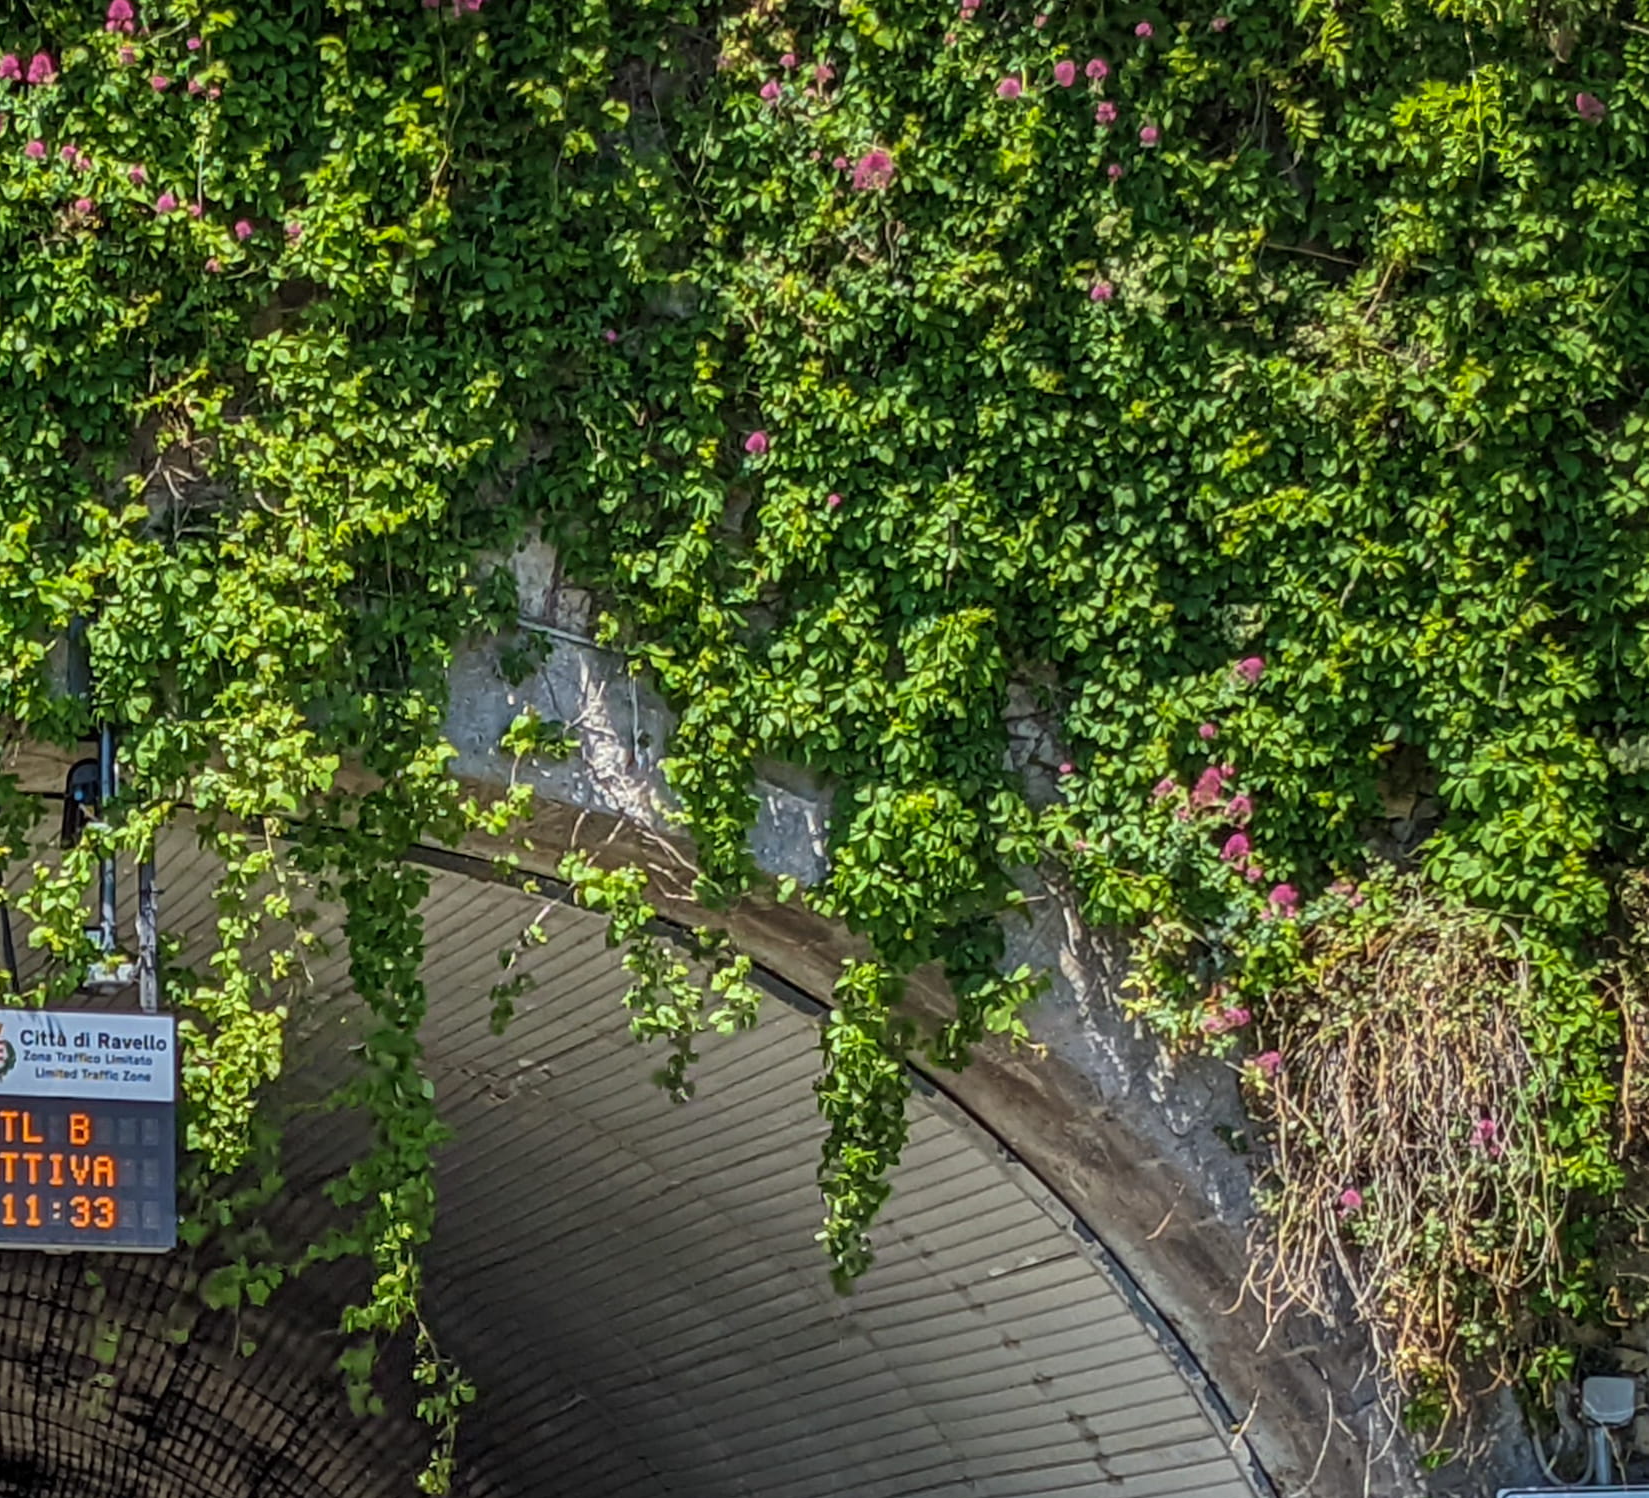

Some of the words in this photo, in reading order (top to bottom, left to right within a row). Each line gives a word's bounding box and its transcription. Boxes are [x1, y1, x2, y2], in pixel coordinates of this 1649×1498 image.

[20, 1030, 67, 1048] Città
[74, 1031, 90, 1048] di
[98, 1033, 168, 1051] Ravello
[23, 1051, 51, 1062] Zona
[56, 1052, 101, 1064] Traffico
[105, 1053, 153, 1066] Limitato
[35, 1067, 77, 1080] Limited
[81, 1068, 118, 1081] Traffic
[122, 1070, 152, 1082] Zone
[69, 1113, 91, 1146] B
[1, 1193, 115, 1229] 11:33
